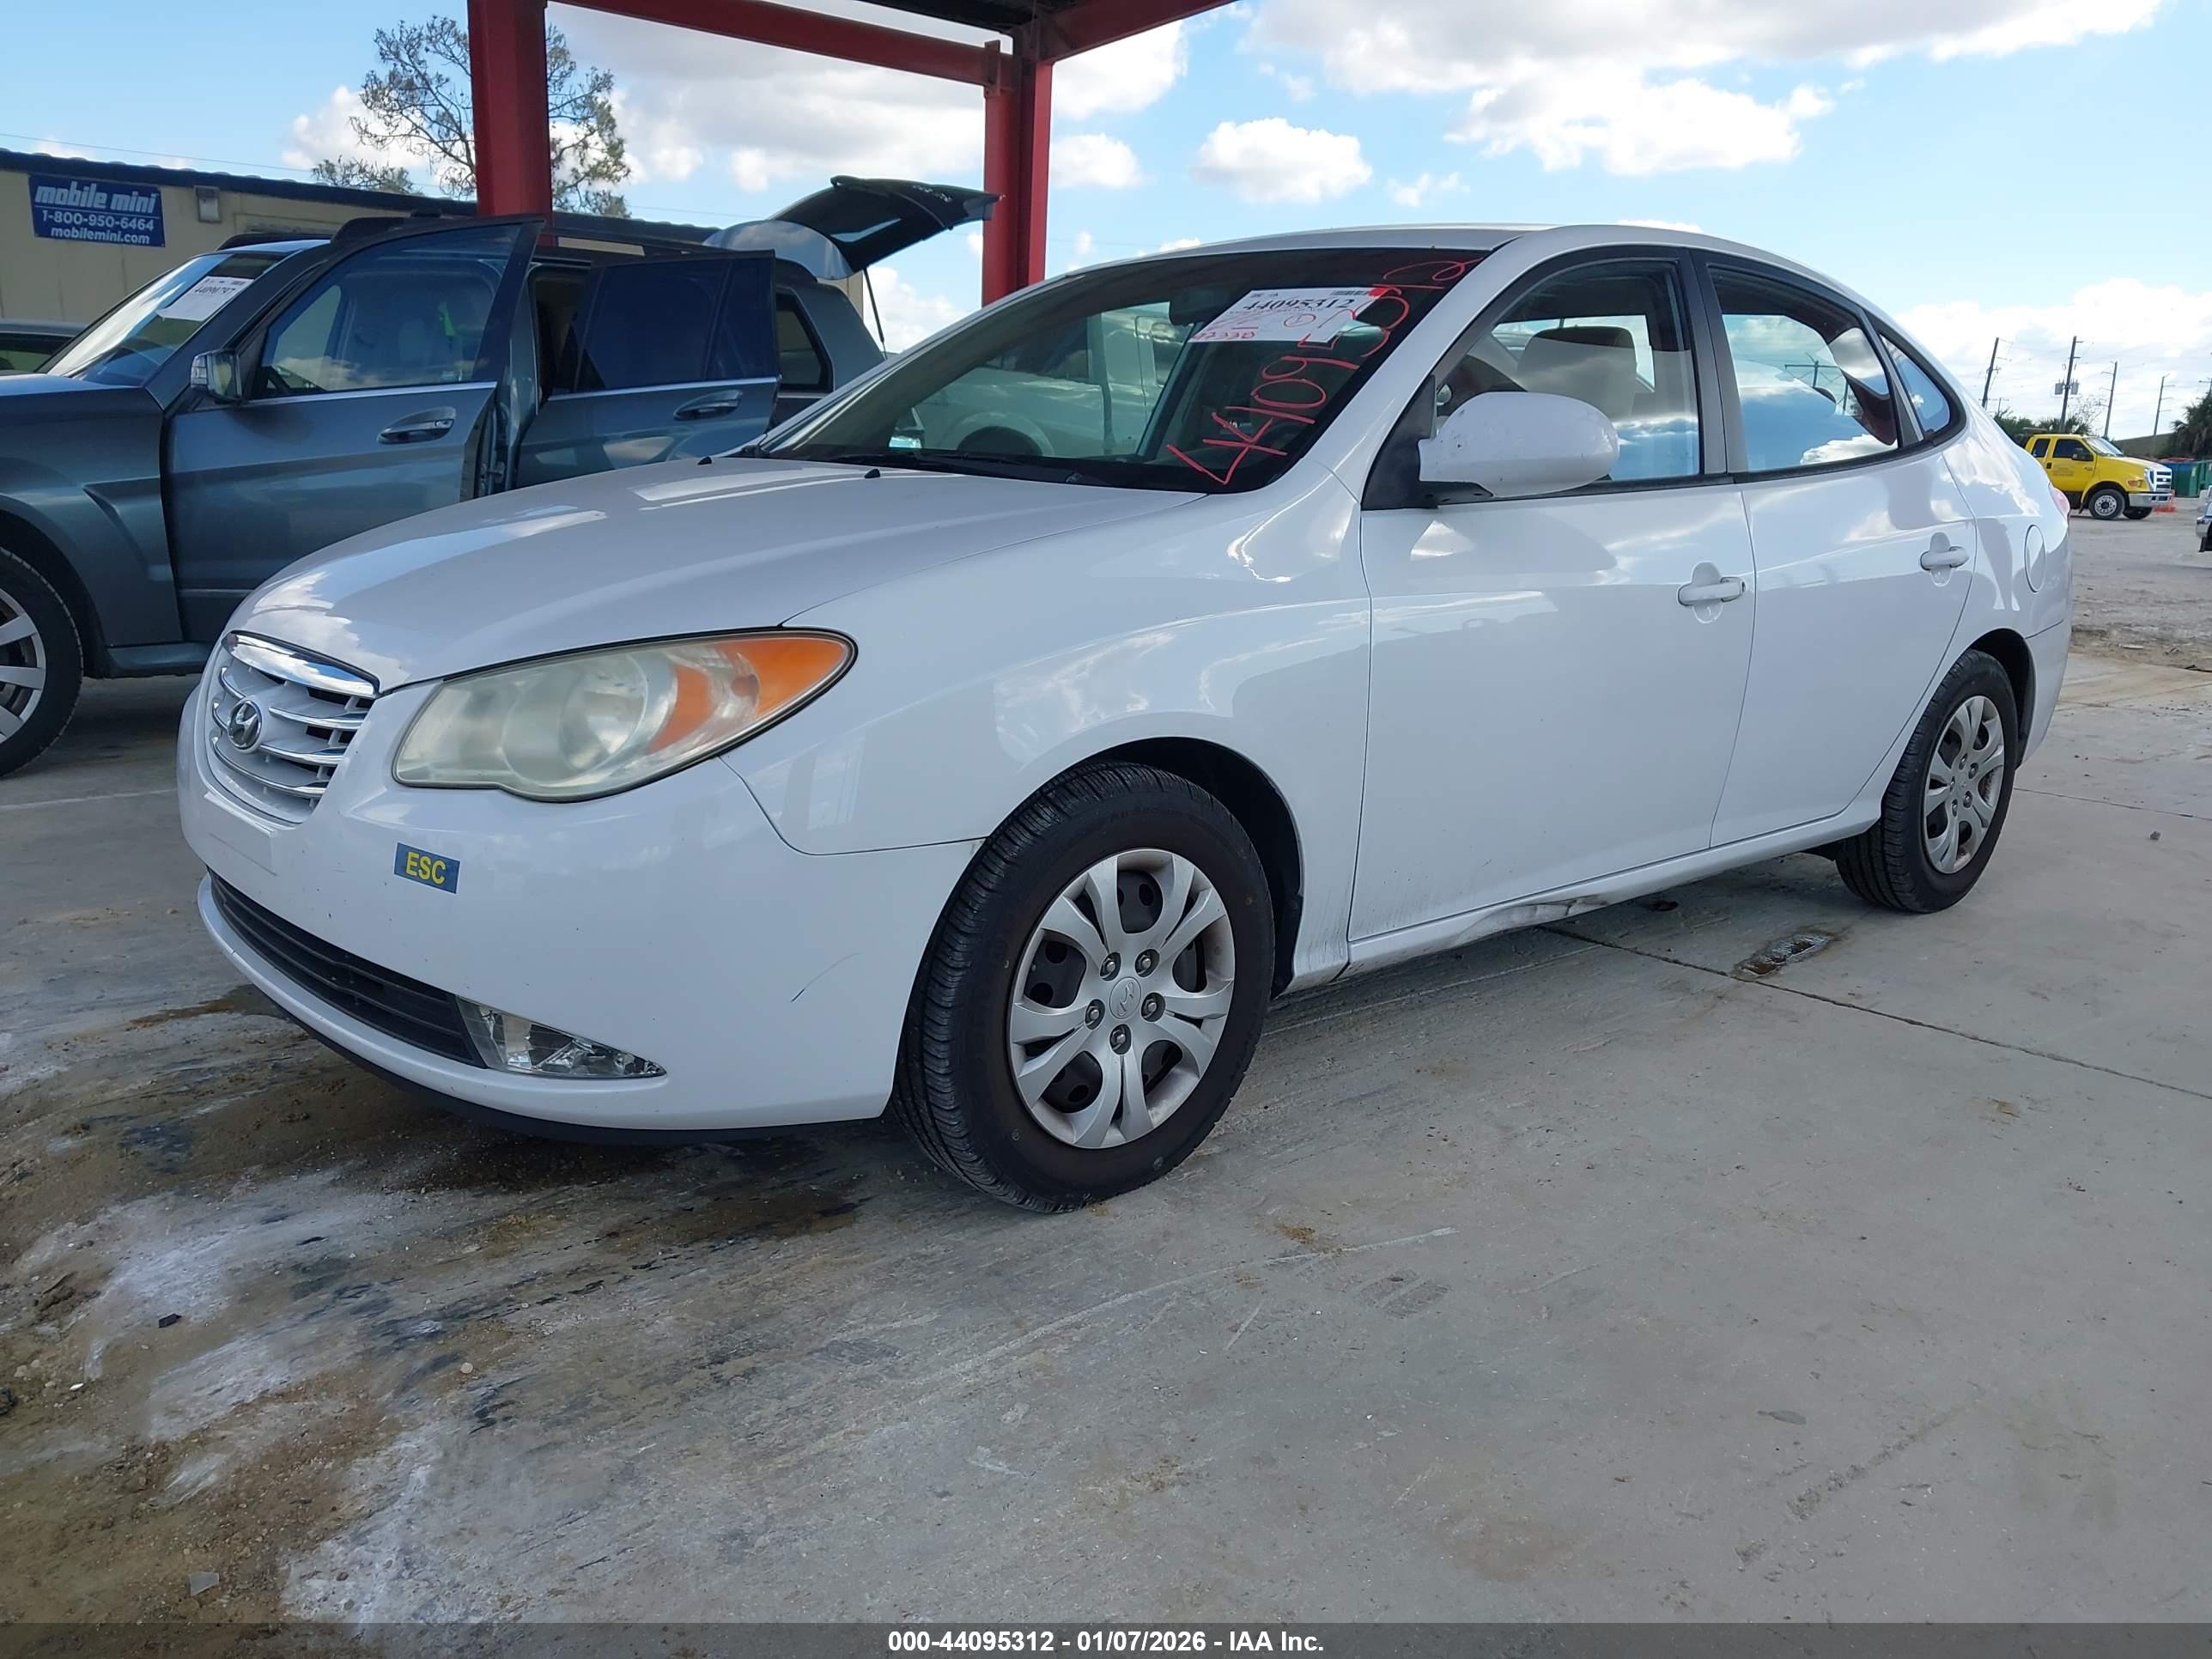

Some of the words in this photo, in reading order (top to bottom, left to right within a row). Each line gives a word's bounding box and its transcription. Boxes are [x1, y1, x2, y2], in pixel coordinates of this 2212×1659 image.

[34, 180, 107, 209] mobile
[110, 191, 156, 213] mini
[42, 210, 155, 231] 1-800-950-6464
[51, 227, 150, 244] mobilemini.com
[1243, 298, 1356, 310] 44095312
[406, 851, 446, 884] ESC
